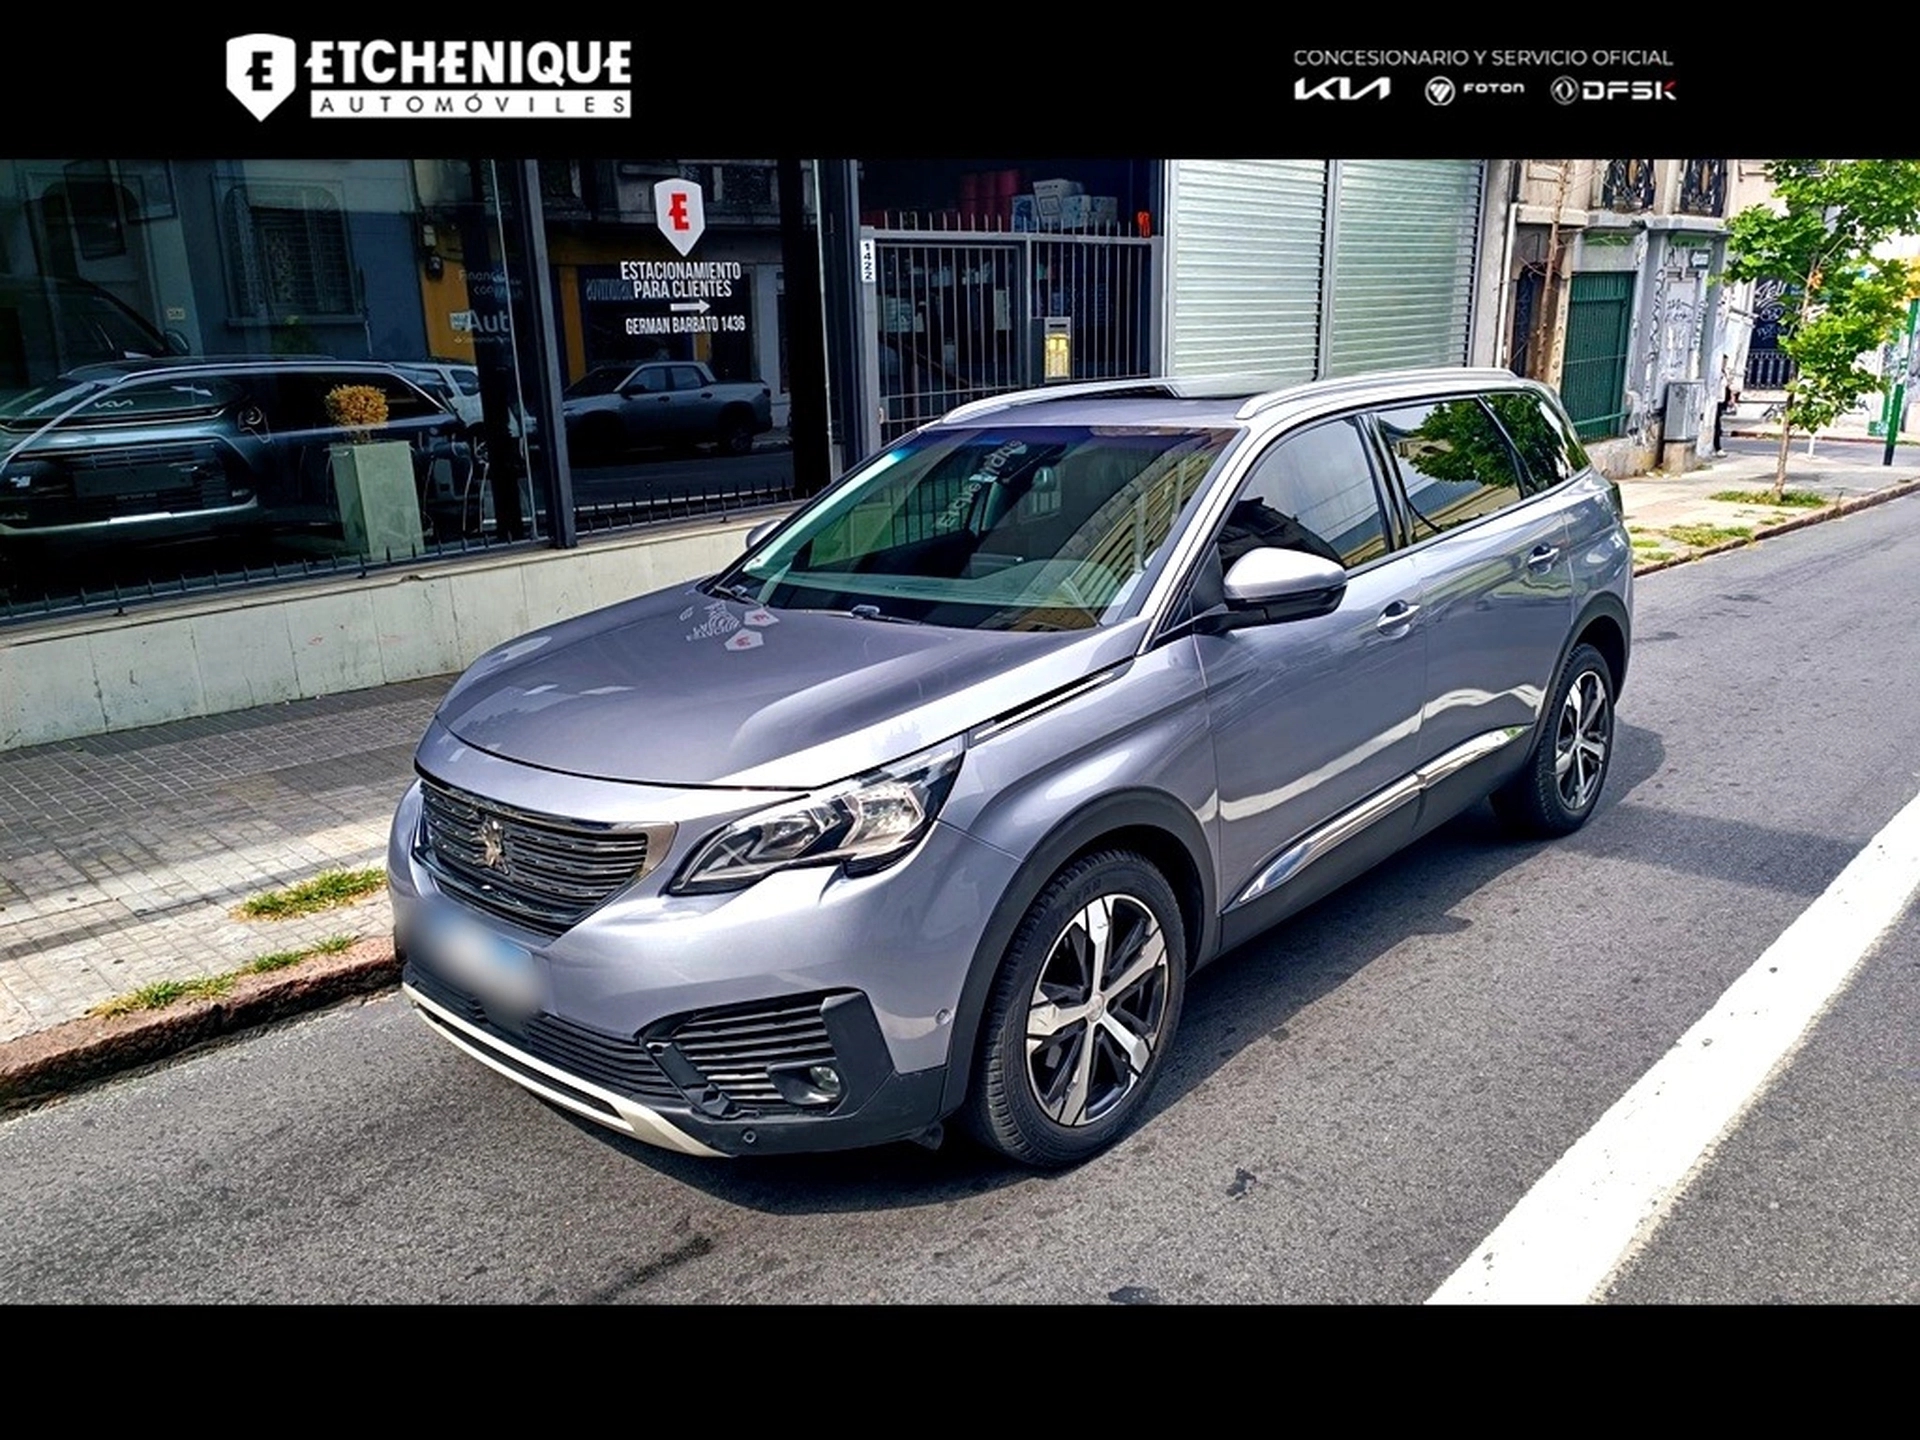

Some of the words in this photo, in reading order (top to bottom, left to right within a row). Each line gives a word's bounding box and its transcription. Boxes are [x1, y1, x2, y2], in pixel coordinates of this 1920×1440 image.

[620, 261, 741, 281] ESTACIONAMIENTO
[633, 280, 670, 299] PARA
[672, 279, 732, 298] CLIENTES
[625, 317, 670, 335] GERMAN
[672, 315, 718, 333] BARBATO
[721, 315, 746, 332] 1436
